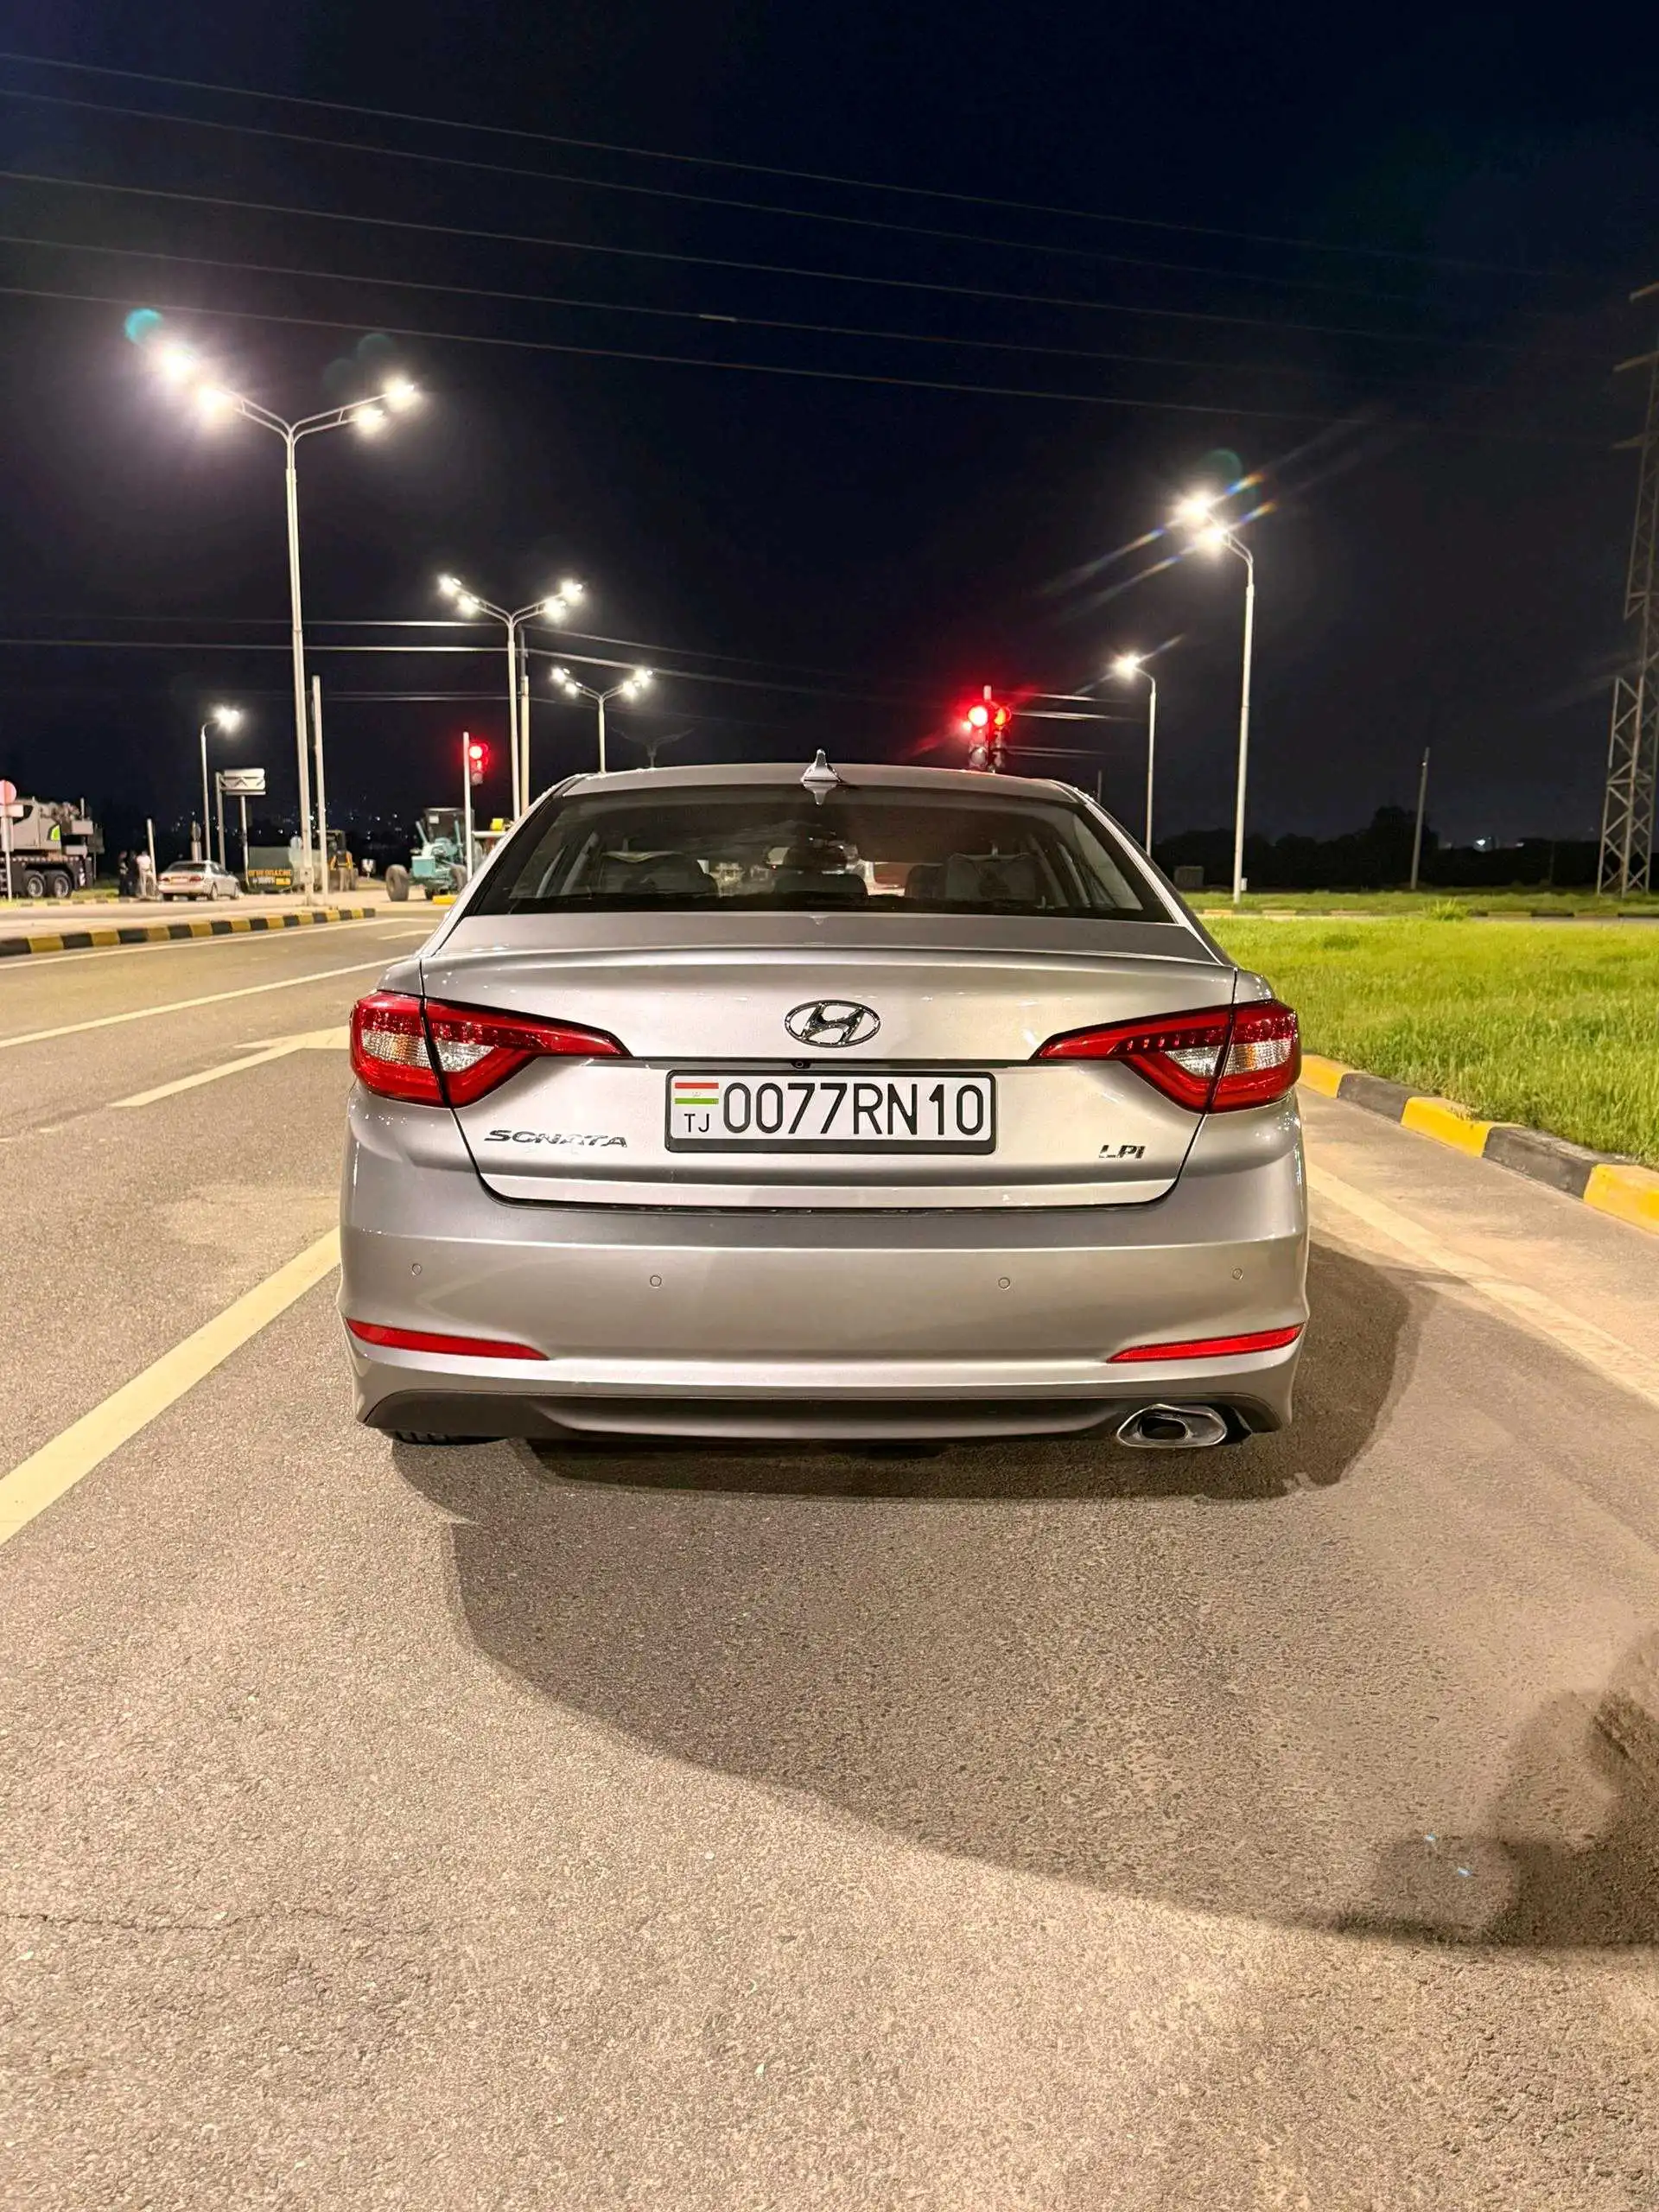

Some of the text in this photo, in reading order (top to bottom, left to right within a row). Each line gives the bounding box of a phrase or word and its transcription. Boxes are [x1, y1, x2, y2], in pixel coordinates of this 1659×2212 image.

[723, 1082, 985, 1135] 0077RN10
[683, 1113, 710, 1133] TJ
[484, 1129, 628, 1148] SONATA
